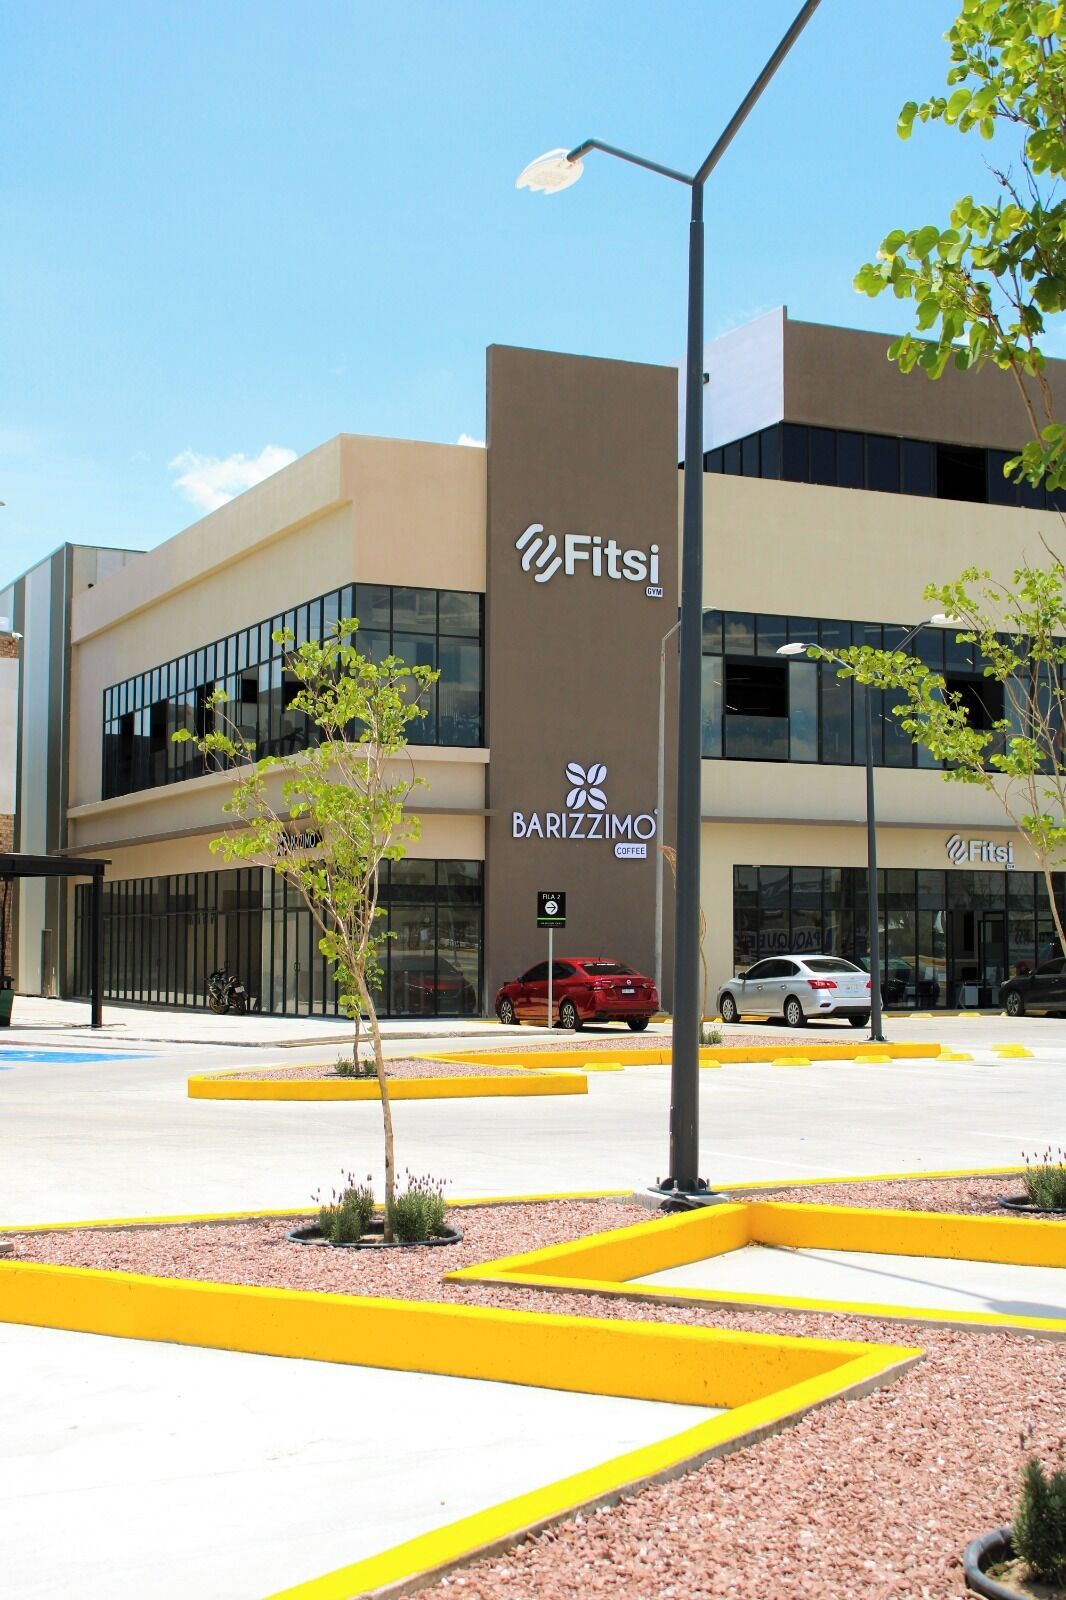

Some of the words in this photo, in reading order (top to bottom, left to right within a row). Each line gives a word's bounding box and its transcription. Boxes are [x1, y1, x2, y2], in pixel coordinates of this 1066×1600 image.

[564, 534, 660, 584] Fitsi
[647, 587, 662, 596] GYM
[512, 811, 657, 840] BARIZZIMO
[616, 847, 646, 855] COFFEE
[968, 840, 1014, 863] Fitsi
